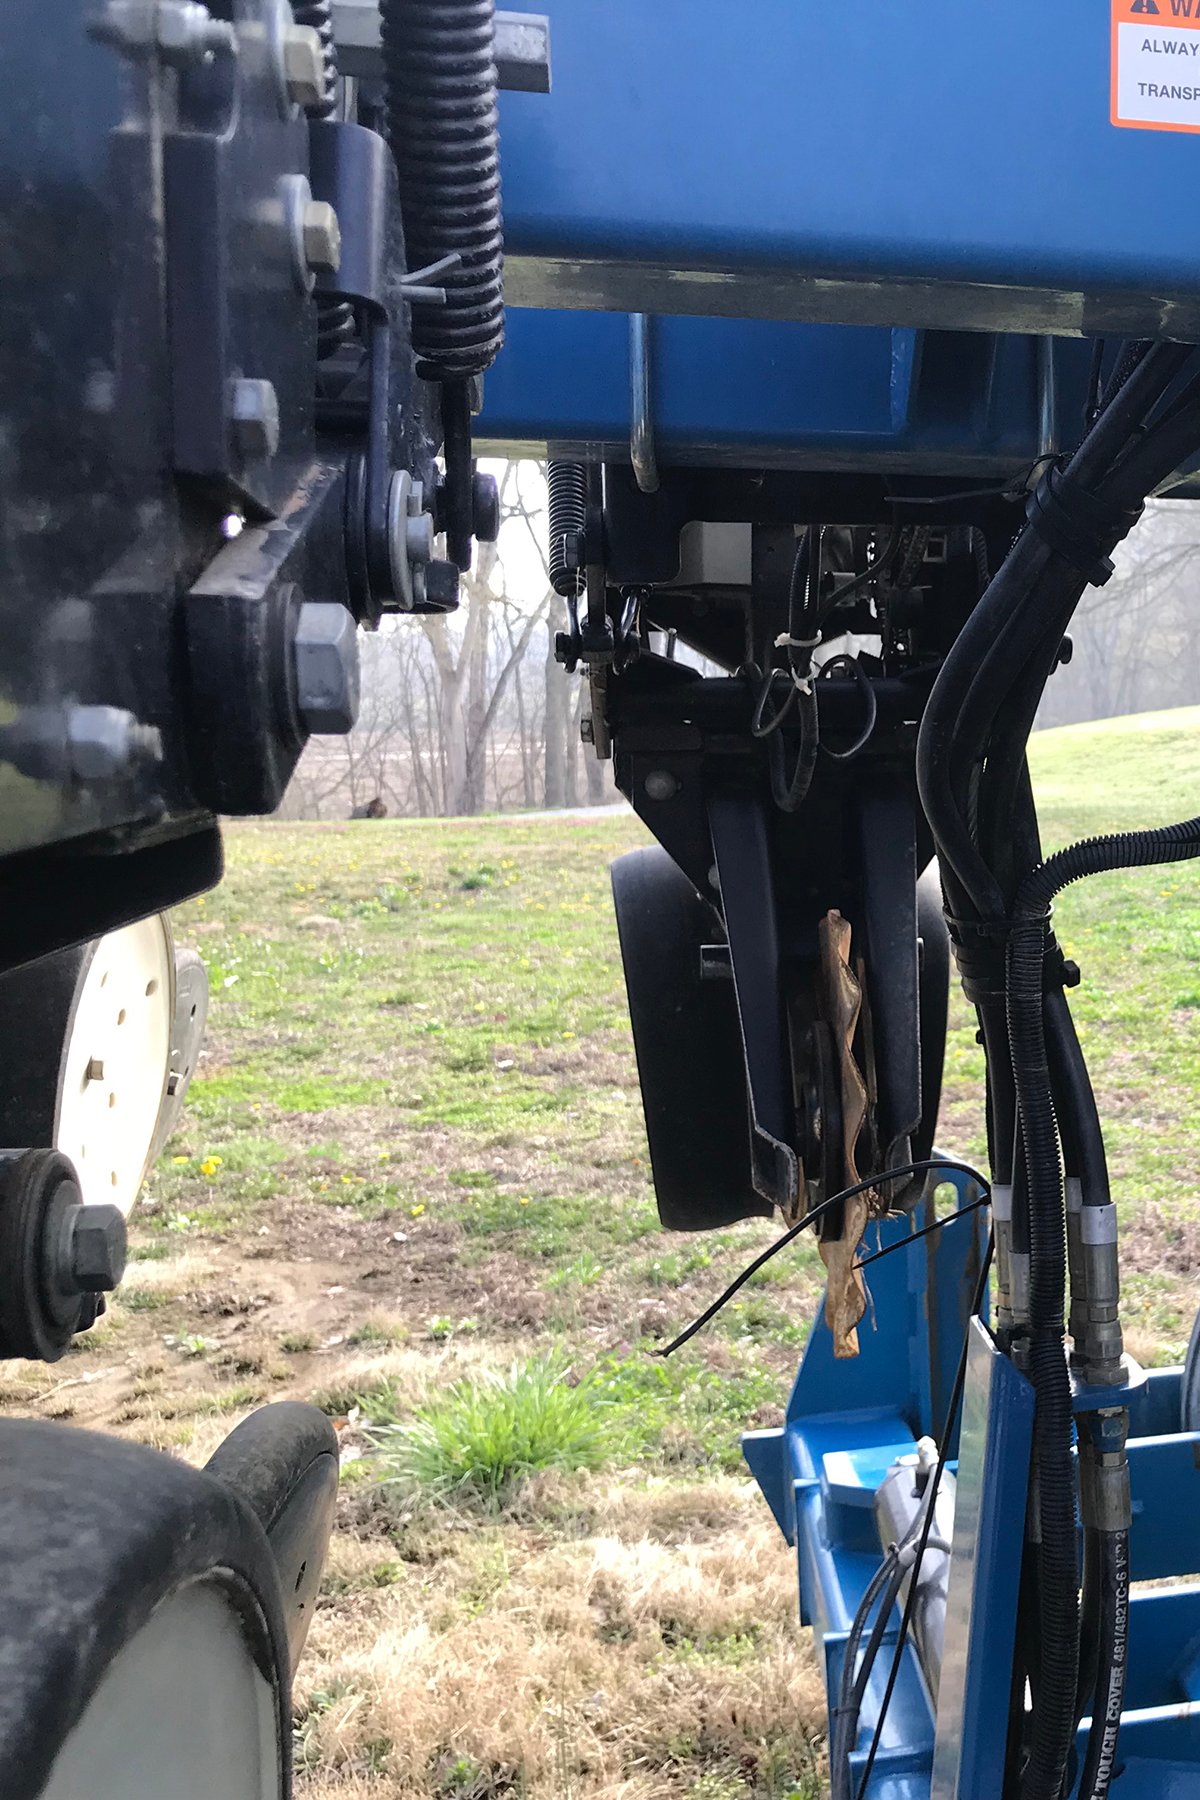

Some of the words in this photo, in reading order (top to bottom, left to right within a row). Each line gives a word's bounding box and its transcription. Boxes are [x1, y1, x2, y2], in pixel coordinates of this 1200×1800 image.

[1114, 1572, 1127, 1661] 481/482TC-6
[1106, 1666, 1123, 1721] COVER
[1094, 1726, 1118, 1791] TOUGH
